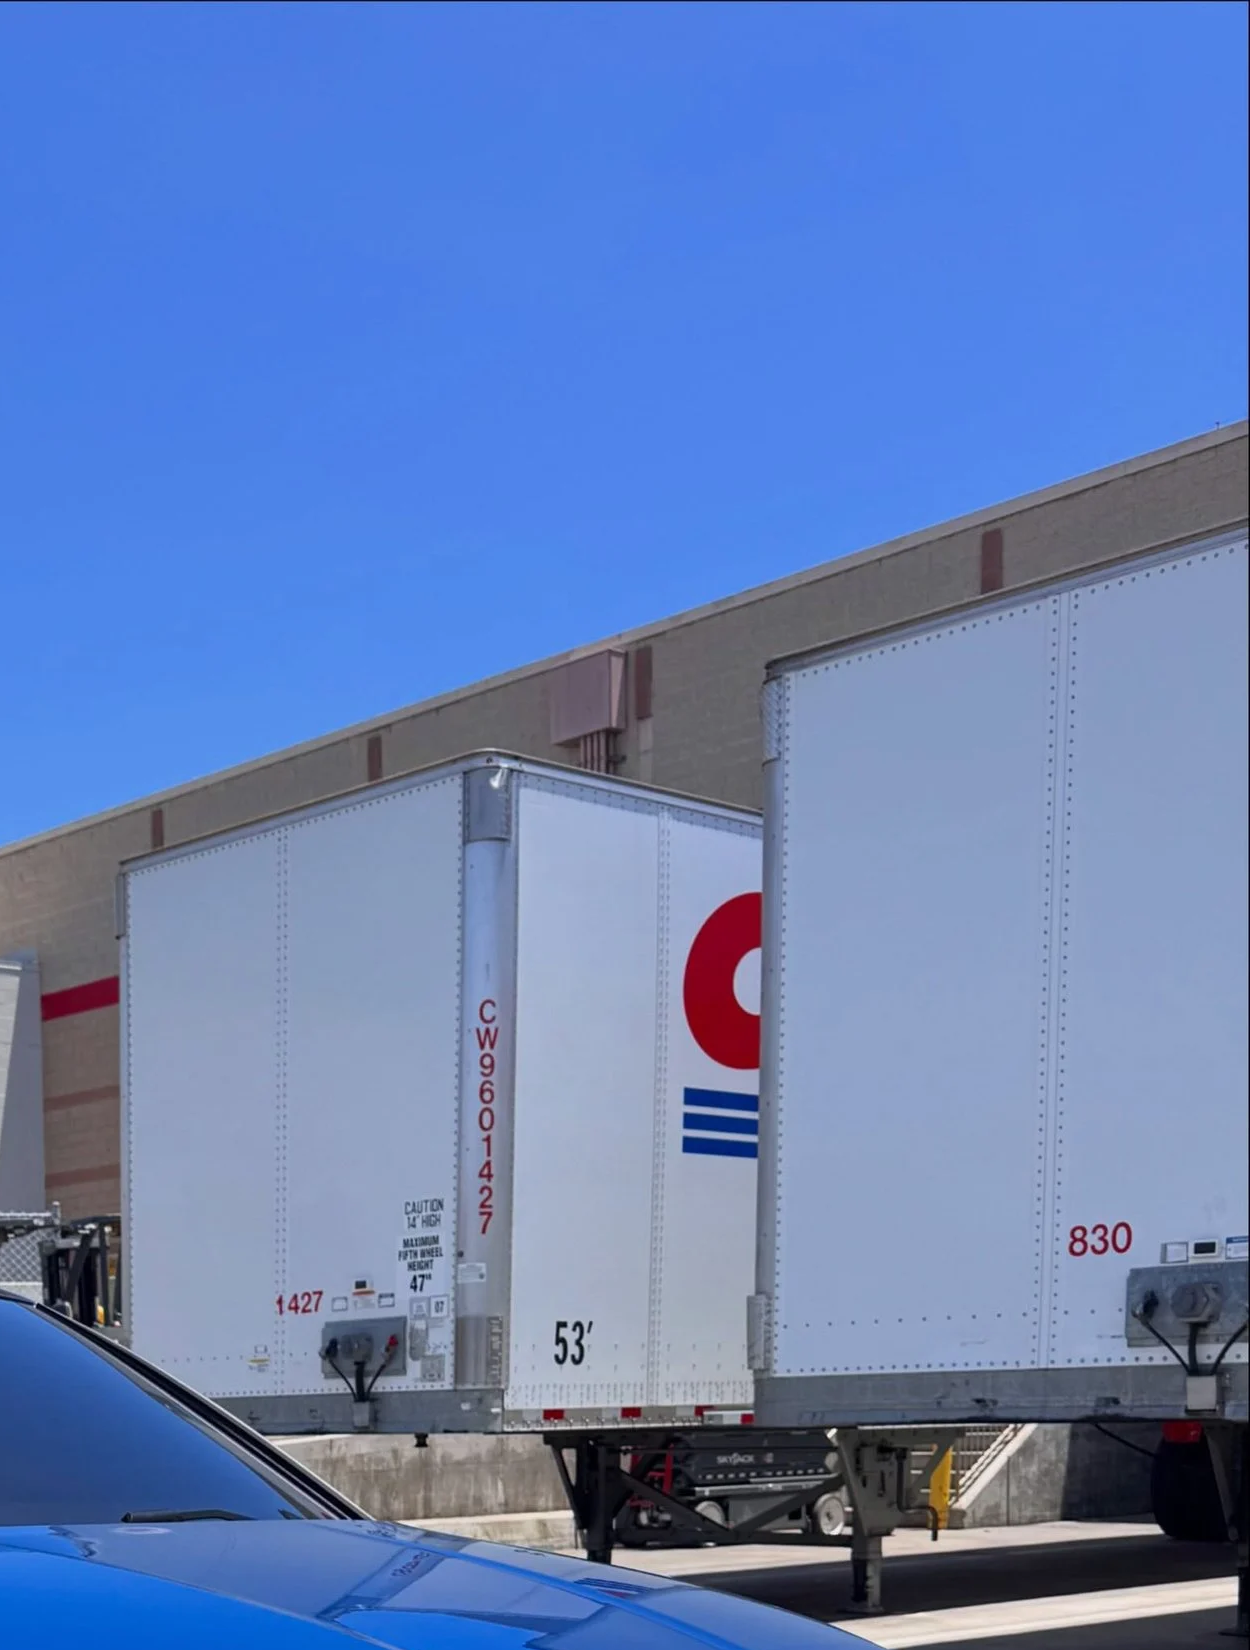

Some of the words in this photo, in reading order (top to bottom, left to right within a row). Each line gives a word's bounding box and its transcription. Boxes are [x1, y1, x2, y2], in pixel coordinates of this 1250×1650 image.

[476, 999, 499, 1234] CW9601427
[404, 1198, 444, 1215] CAUTION
[421, 1213, 441, 1228] HIGH
[403, 1235, 440, 1248] MAXIMUM
[398, 1249, 418, 1261] FIFTH
[420, 1246, 443, 1259] WHEEL
[407, 1259, 434, 1271] HEIGHT
[276, 1290, 323, 1315] 1427
[554, 1320, 593, 1365] 53'
[716, 1452, 755, 1465] SKYJACK
